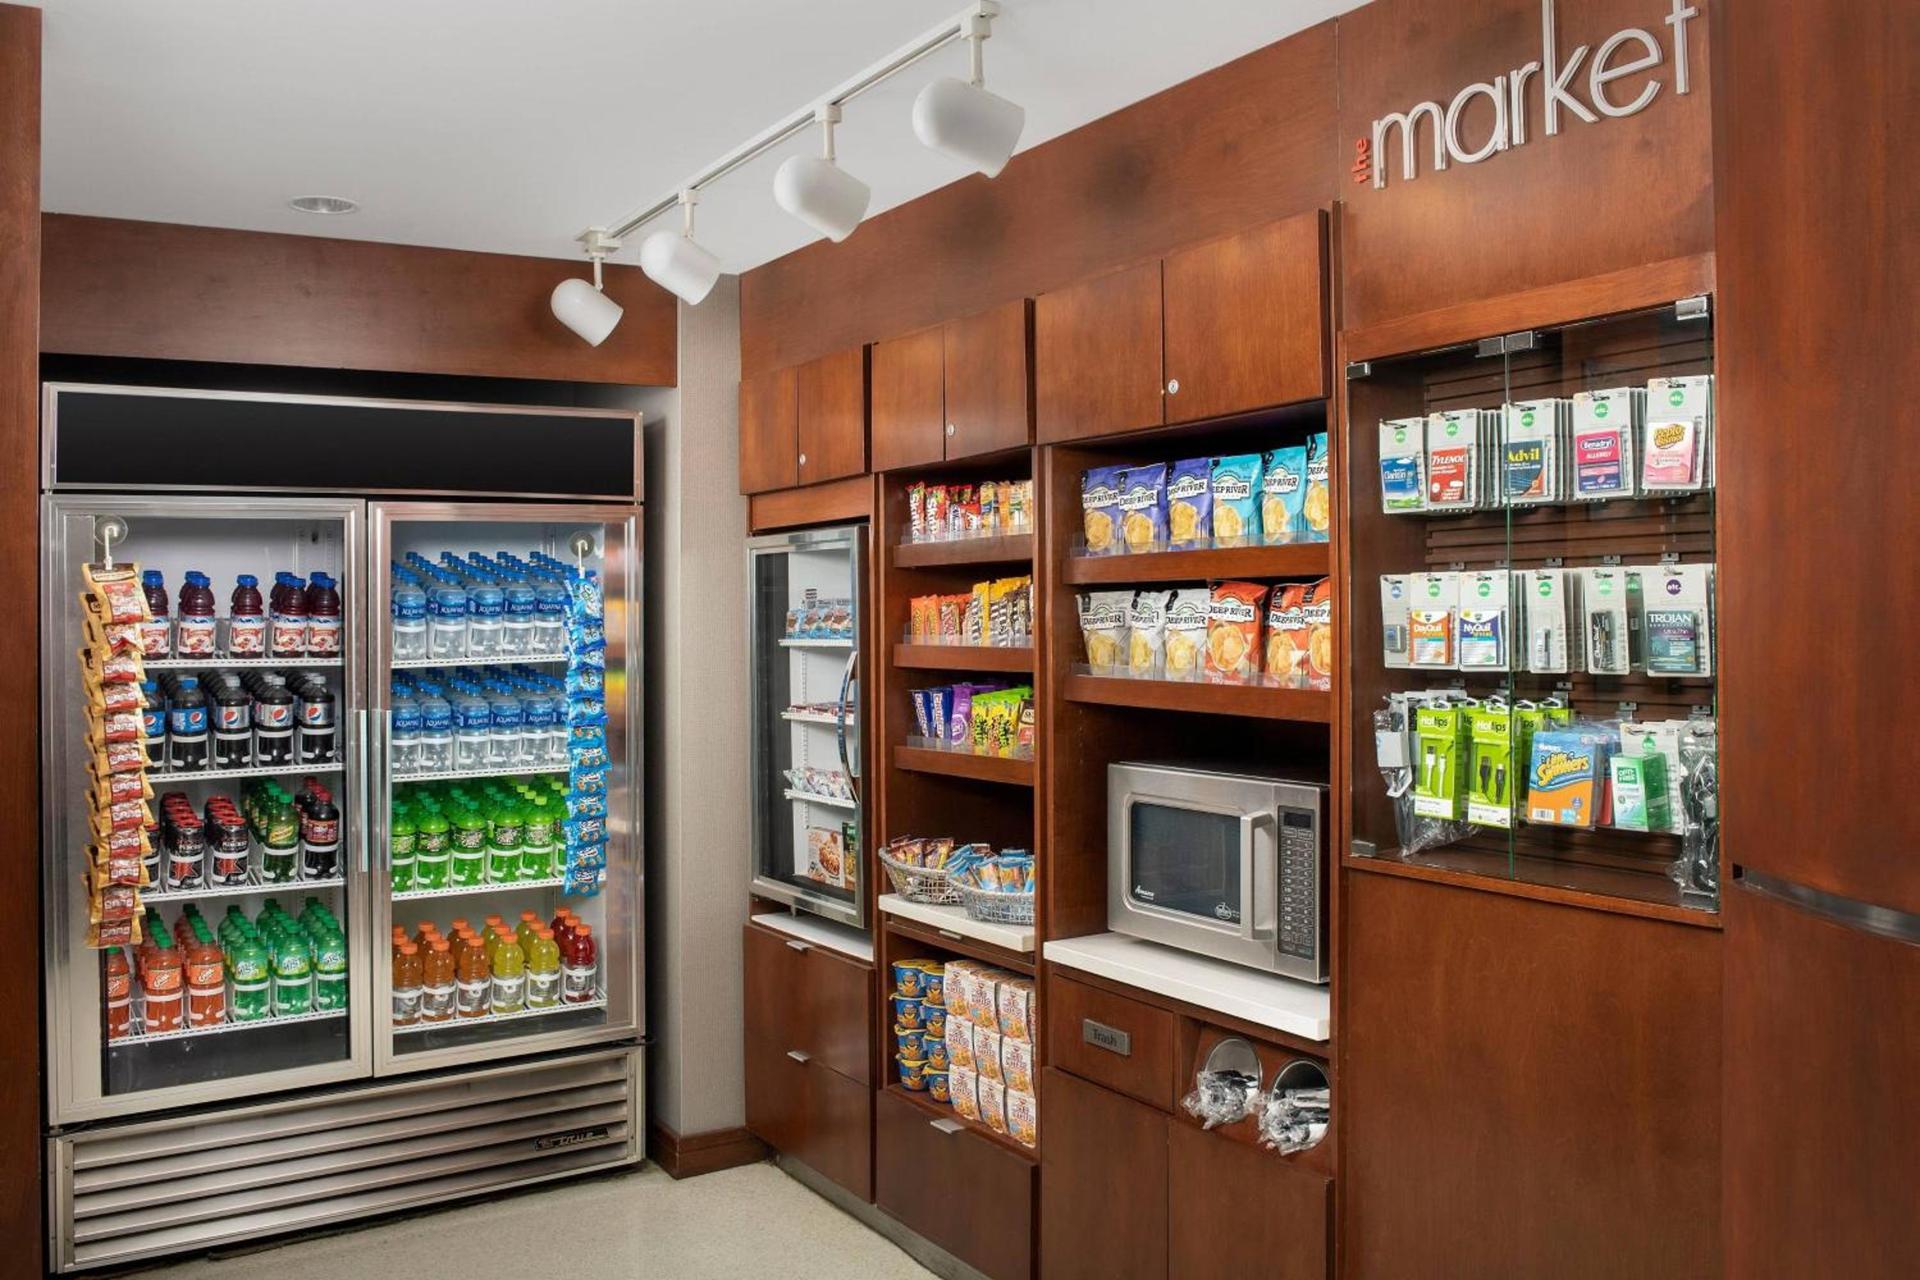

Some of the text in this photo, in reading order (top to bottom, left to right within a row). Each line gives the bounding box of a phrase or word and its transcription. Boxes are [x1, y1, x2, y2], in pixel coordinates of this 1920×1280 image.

[1353, 0, 1699, 190] the market
[1583, 439, 1613, 449] Benadryl
[1432, 455, 1464, 466] TYLENOL
[1507, 447, 1540, 463] Advil
[1181, 482, 1205, 492] RIVER
[1226, 484, 1248, 495] RIVER
[1230, 606, 1252, 618] RIVER
[1304, 607, 1327, 619] DEEP
[1648, 612, 1693, 624] TROJAN
[1099, 615, 1122, 625] RIVER
[1183, 615, 1206, 625] RIVER
[1413, 623, 1442, 635] DayQuil
[1463, 623, 1492, 635] NyQuil
[1537, 757, 1589, 787] Swimmers
[1092, 1028, 1118, 1048] Trash
